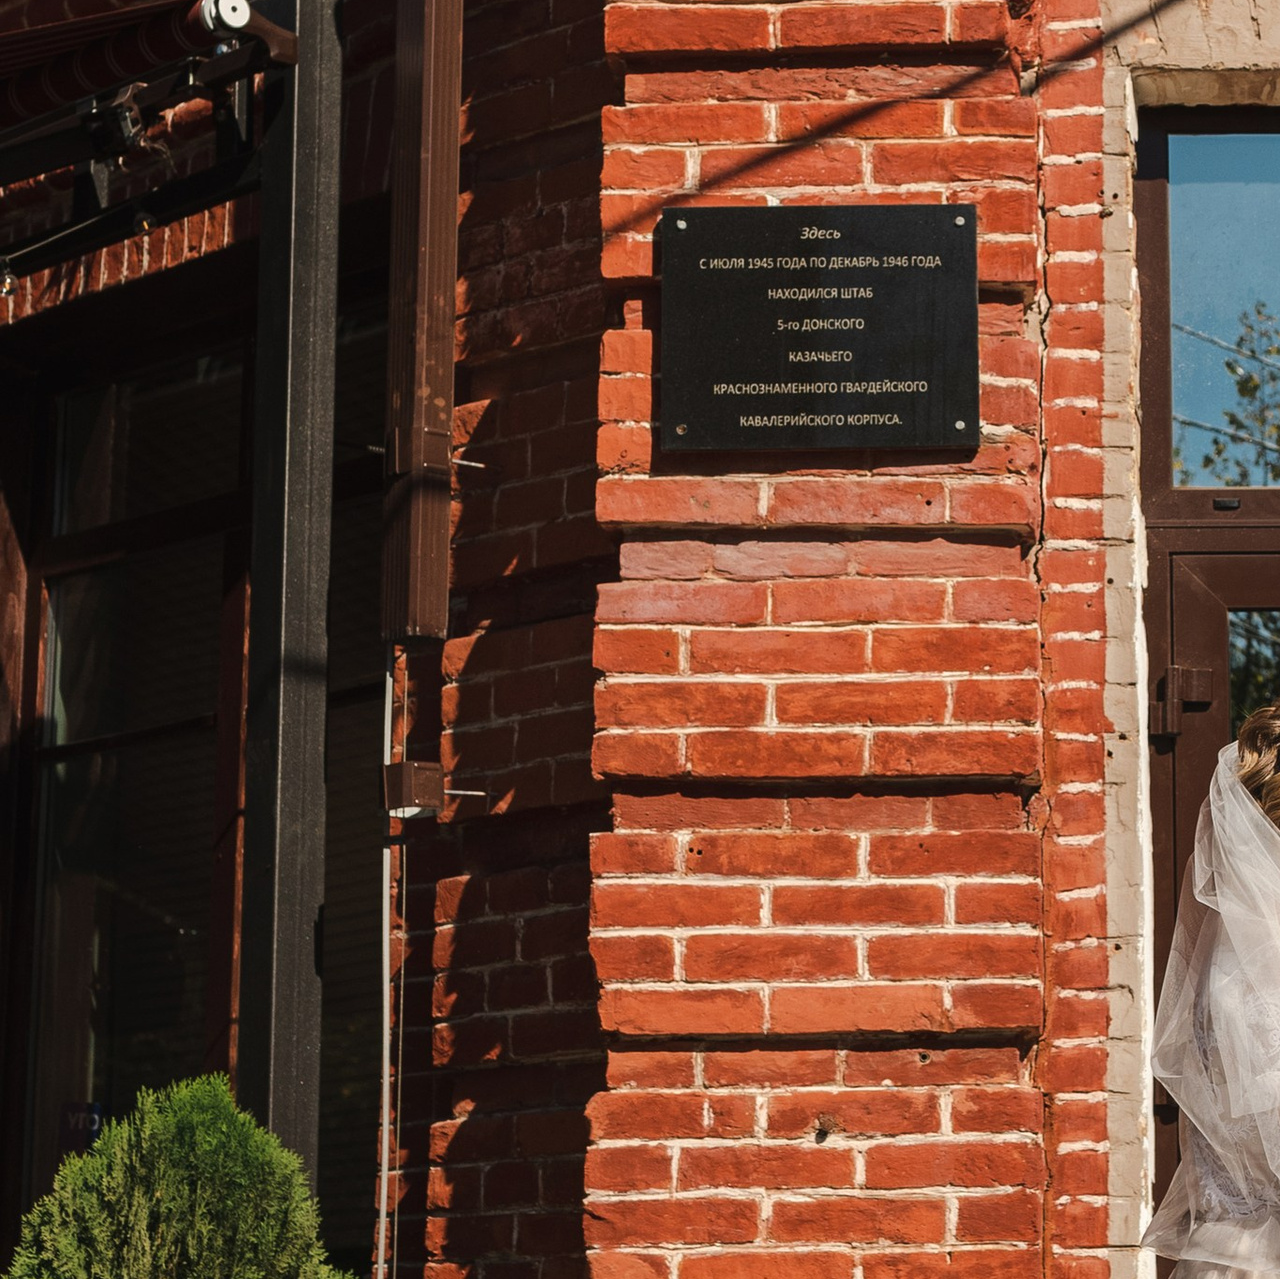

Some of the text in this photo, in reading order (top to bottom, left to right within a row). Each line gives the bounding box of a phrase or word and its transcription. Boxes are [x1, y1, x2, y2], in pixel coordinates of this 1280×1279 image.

[800, 226, 841, 240] Здесь
[699, 256, 942, 270] С ИЮЛЯ 1945 ГОДА ПО ДЕКАБРЬ 1946 ГОДА
[768, 287, 873, 301] НАХОДИЛСЯ ШТАБ
[777, 318, 864, 332] 5-го ДОНСКОГО
[788, 351, 853, 362] КАЗАЧЬЕГО
[713, 379, 928, 395] КРАСНОЗНАМЕННОГО ГВАРДЕЙСКОГО
[740, 412, 902, 427] КАВАЛЕРИЙСКОГО КОРПУСА.
